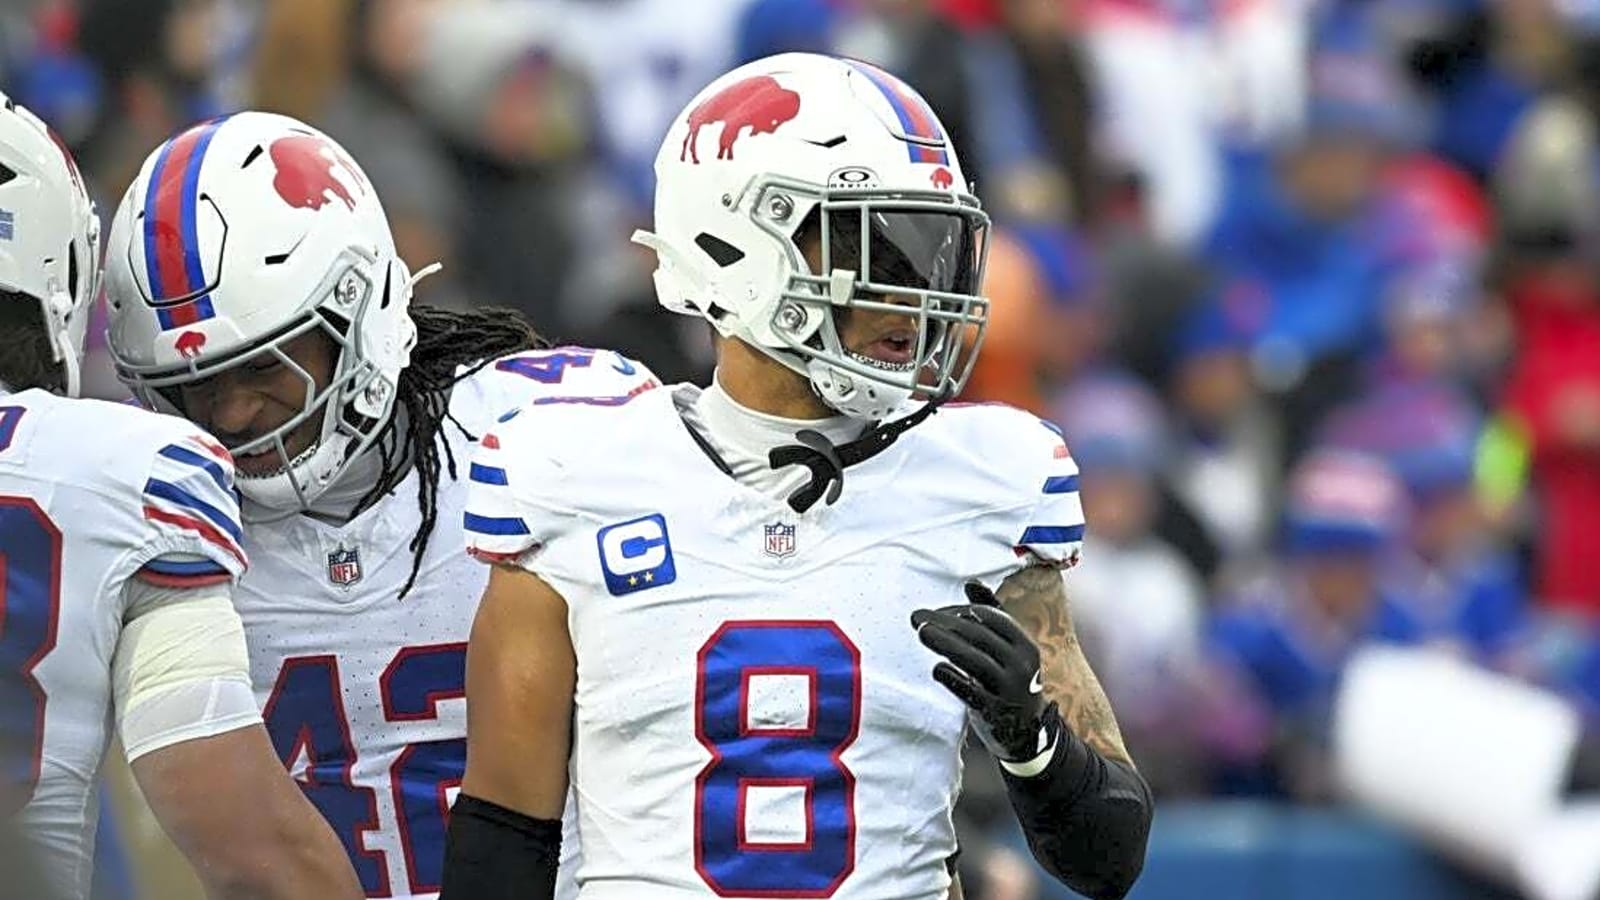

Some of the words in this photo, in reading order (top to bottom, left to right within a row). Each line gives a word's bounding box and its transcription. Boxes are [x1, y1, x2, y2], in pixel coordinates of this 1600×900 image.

[603, 520, 667, 576] C
[769, 536, 792, 552] NFL
[332, 562, 358, 582] NFL
[694, 620, 862, 899] 8
